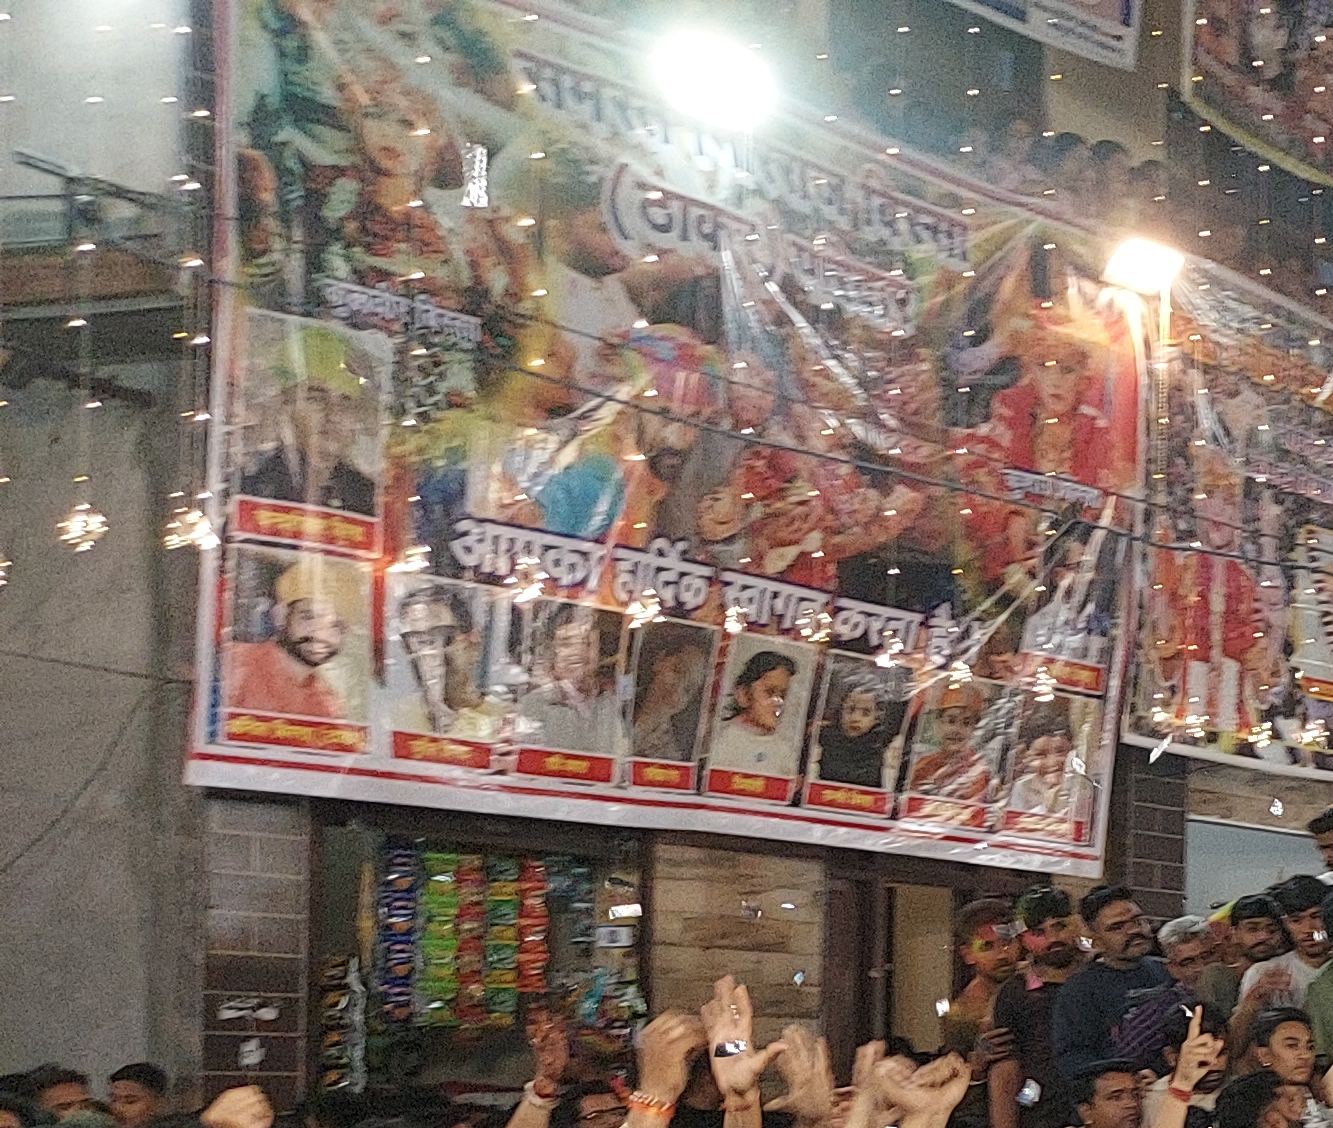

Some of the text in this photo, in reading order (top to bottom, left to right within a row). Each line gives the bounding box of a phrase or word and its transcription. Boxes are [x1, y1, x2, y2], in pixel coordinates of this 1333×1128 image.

[449, 517, 607, 594] आपका
[611, 537, 715, 612] हार्दिक
[720, 568, 833, 634] स्वागत
